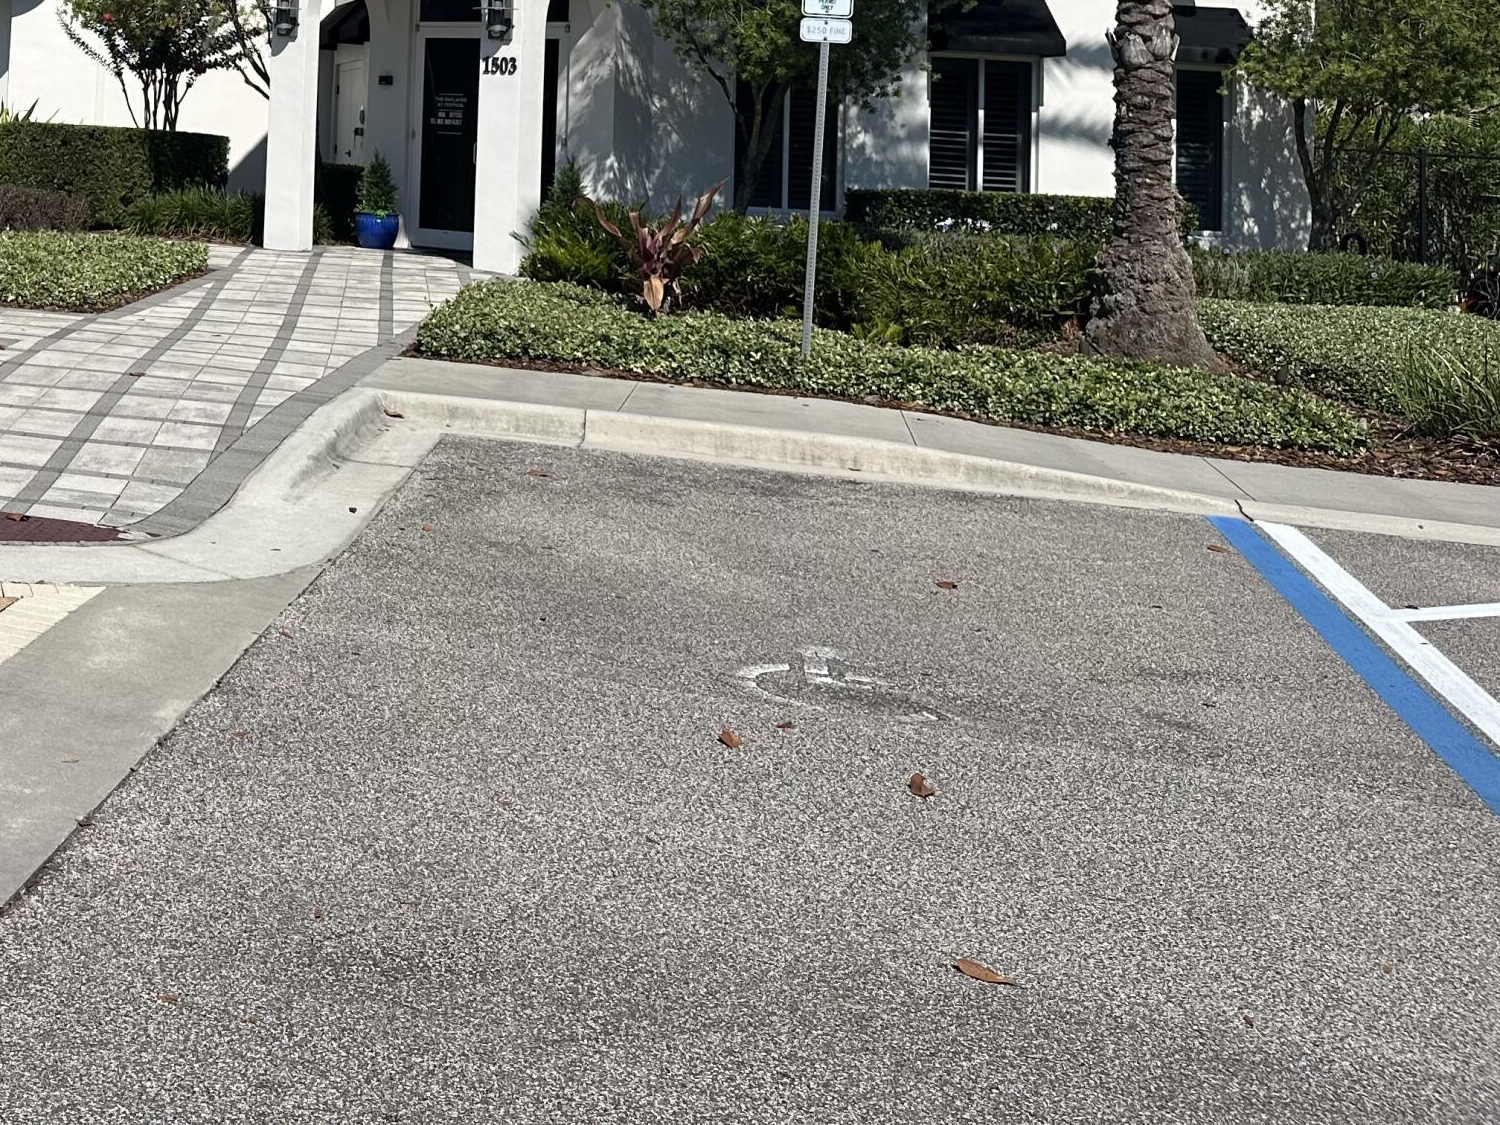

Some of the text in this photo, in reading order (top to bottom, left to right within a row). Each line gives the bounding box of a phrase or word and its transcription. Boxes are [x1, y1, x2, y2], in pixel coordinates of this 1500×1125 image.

[807, 26, 845, 35] $250 FINE
[482, 56, 517, 75] 1503
